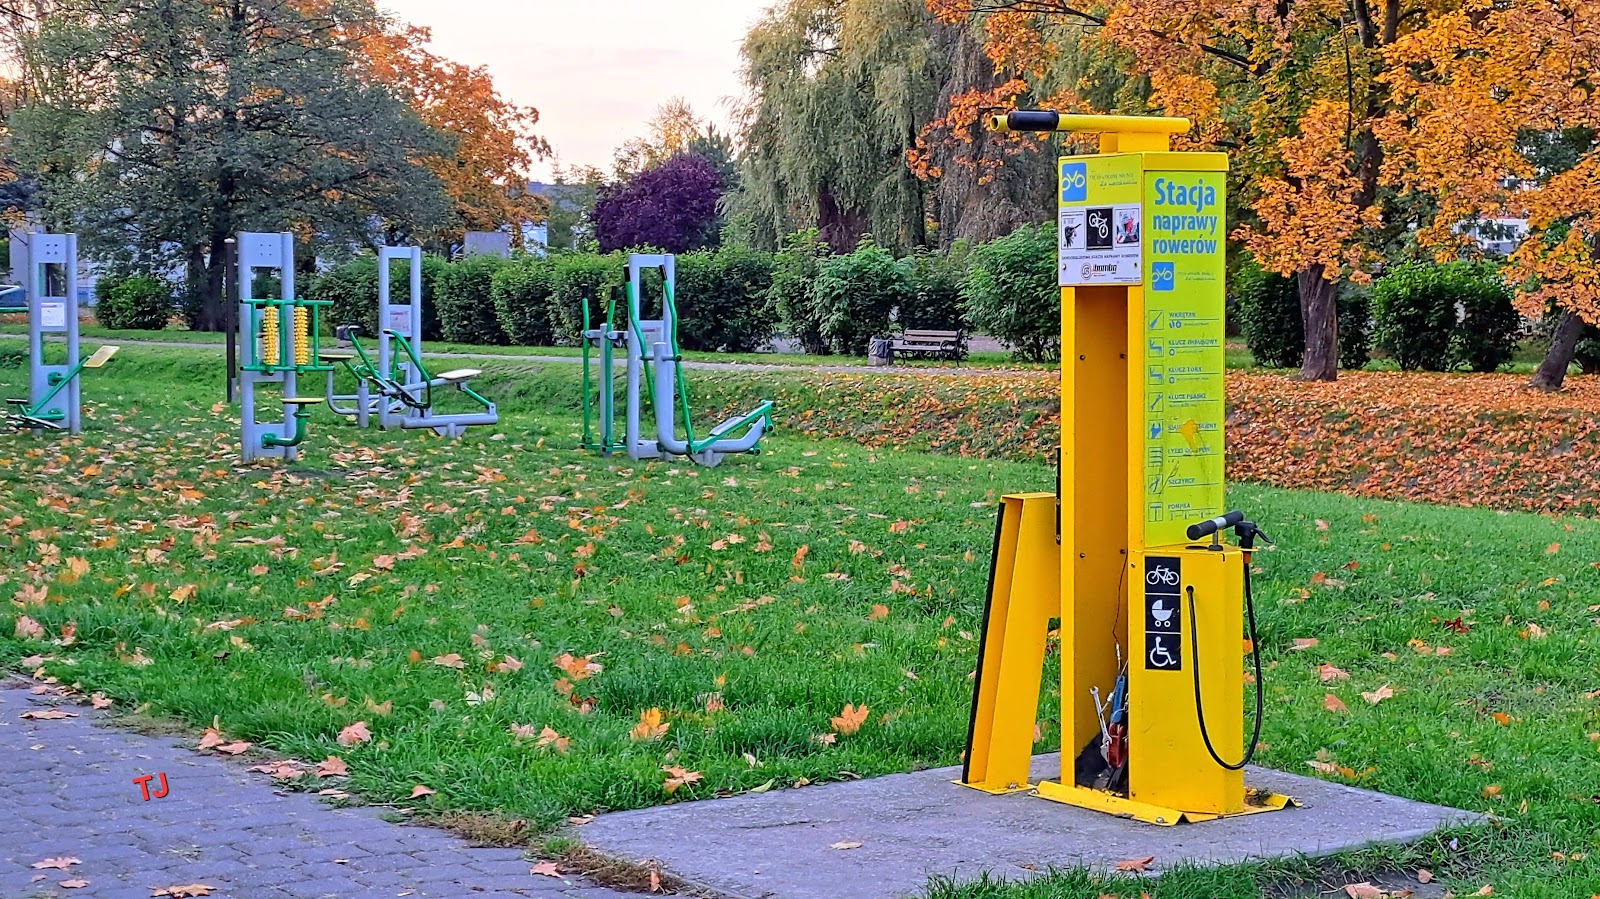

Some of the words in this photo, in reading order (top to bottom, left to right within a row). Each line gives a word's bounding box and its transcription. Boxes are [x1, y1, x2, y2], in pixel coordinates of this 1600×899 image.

[1154, 178, 1215, 213] Stacja
[1152, 215, 1217, 236] naprawy
[1152, 234, 1216, 254] rowerów
